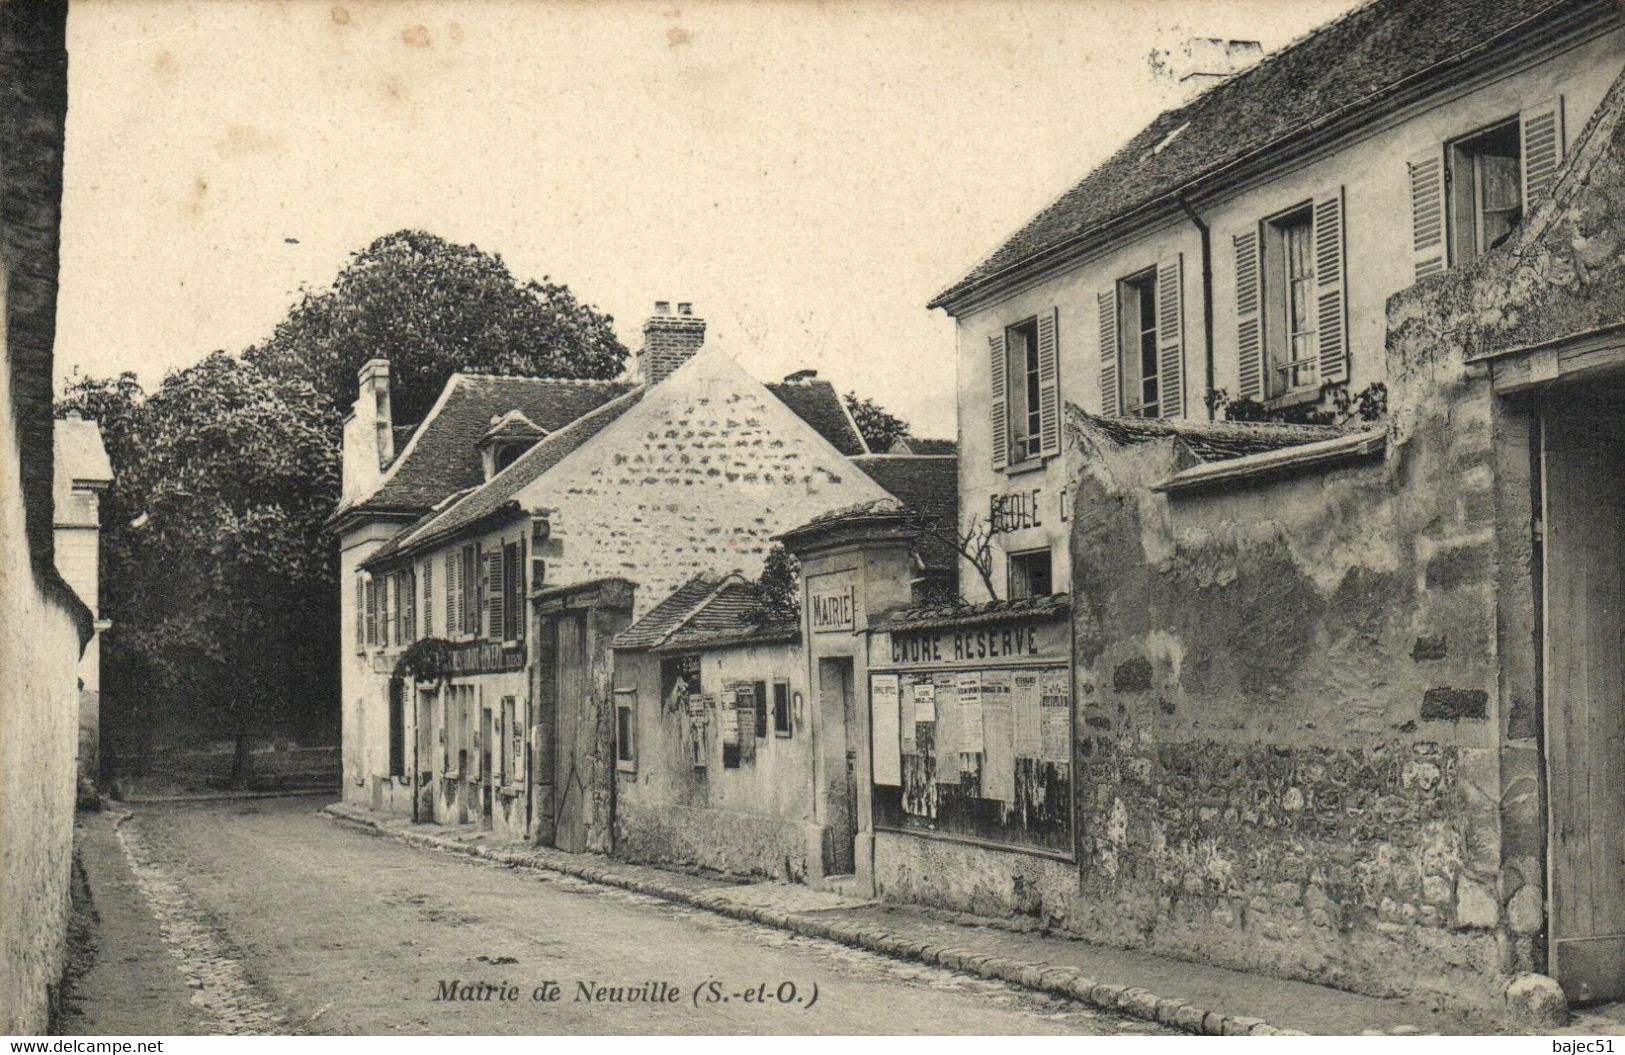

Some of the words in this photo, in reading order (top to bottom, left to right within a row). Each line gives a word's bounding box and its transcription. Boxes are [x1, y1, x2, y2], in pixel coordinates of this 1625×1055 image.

[813, 594, 852, 627] MAIRIE
[891, 634, 942, 663] CADRE
[955, 626, 1038, 661] RESERVE
